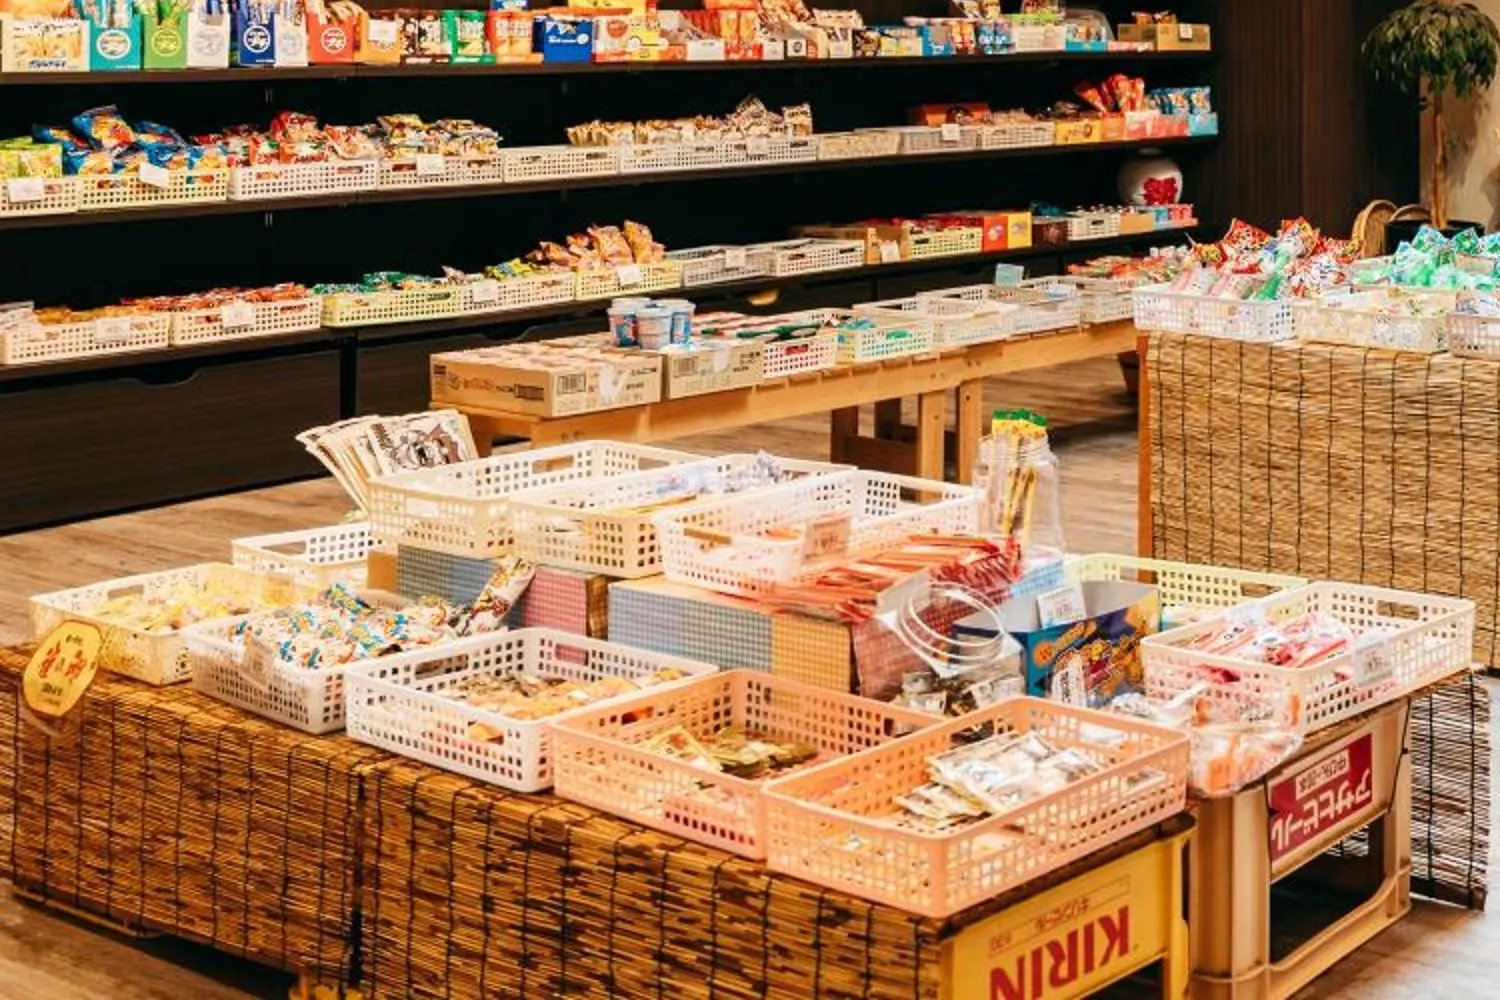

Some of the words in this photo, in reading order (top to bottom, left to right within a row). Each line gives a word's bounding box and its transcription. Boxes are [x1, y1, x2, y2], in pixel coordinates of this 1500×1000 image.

[1270, 768, 1372, 852] アサヒビール
[989, 904, 1130, 1000] KIRIN
